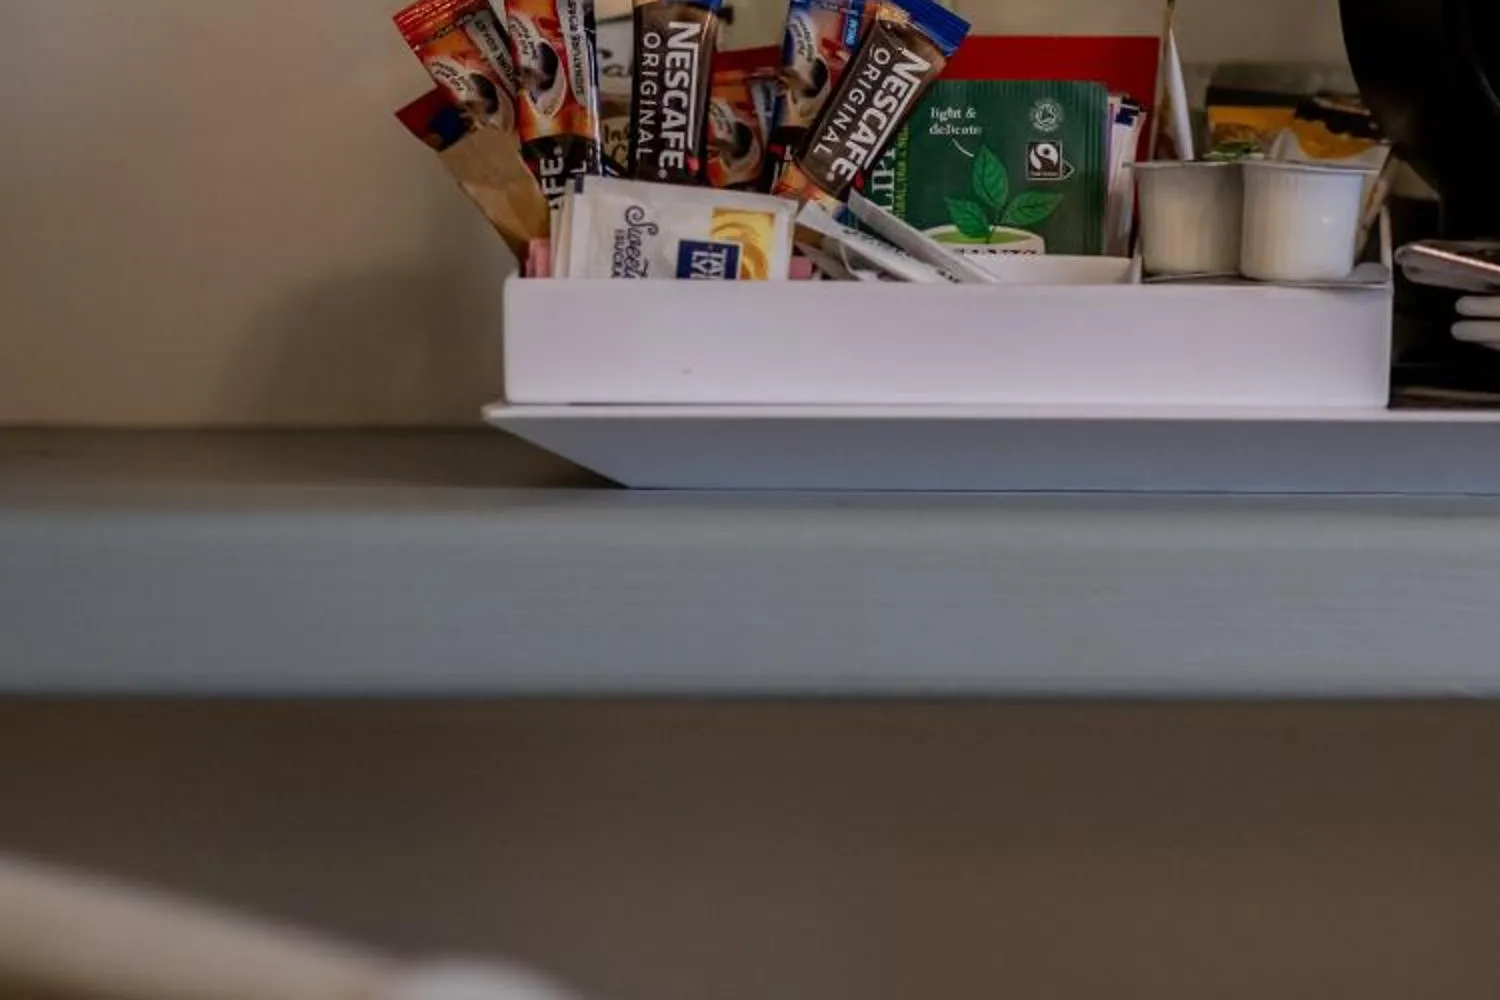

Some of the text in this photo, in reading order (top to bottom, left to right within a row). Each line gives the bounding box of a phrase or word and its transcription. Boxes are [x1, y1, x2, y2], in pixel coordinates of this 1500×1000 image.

[634, 31, 662, 159] ORIGINAL
[812, 46, 892, 157] ORIGINAL
[928, 122, 983, 135] delicate
[930, 106, 977, 122] light &
[624, 205, 659, 278] Sweet
